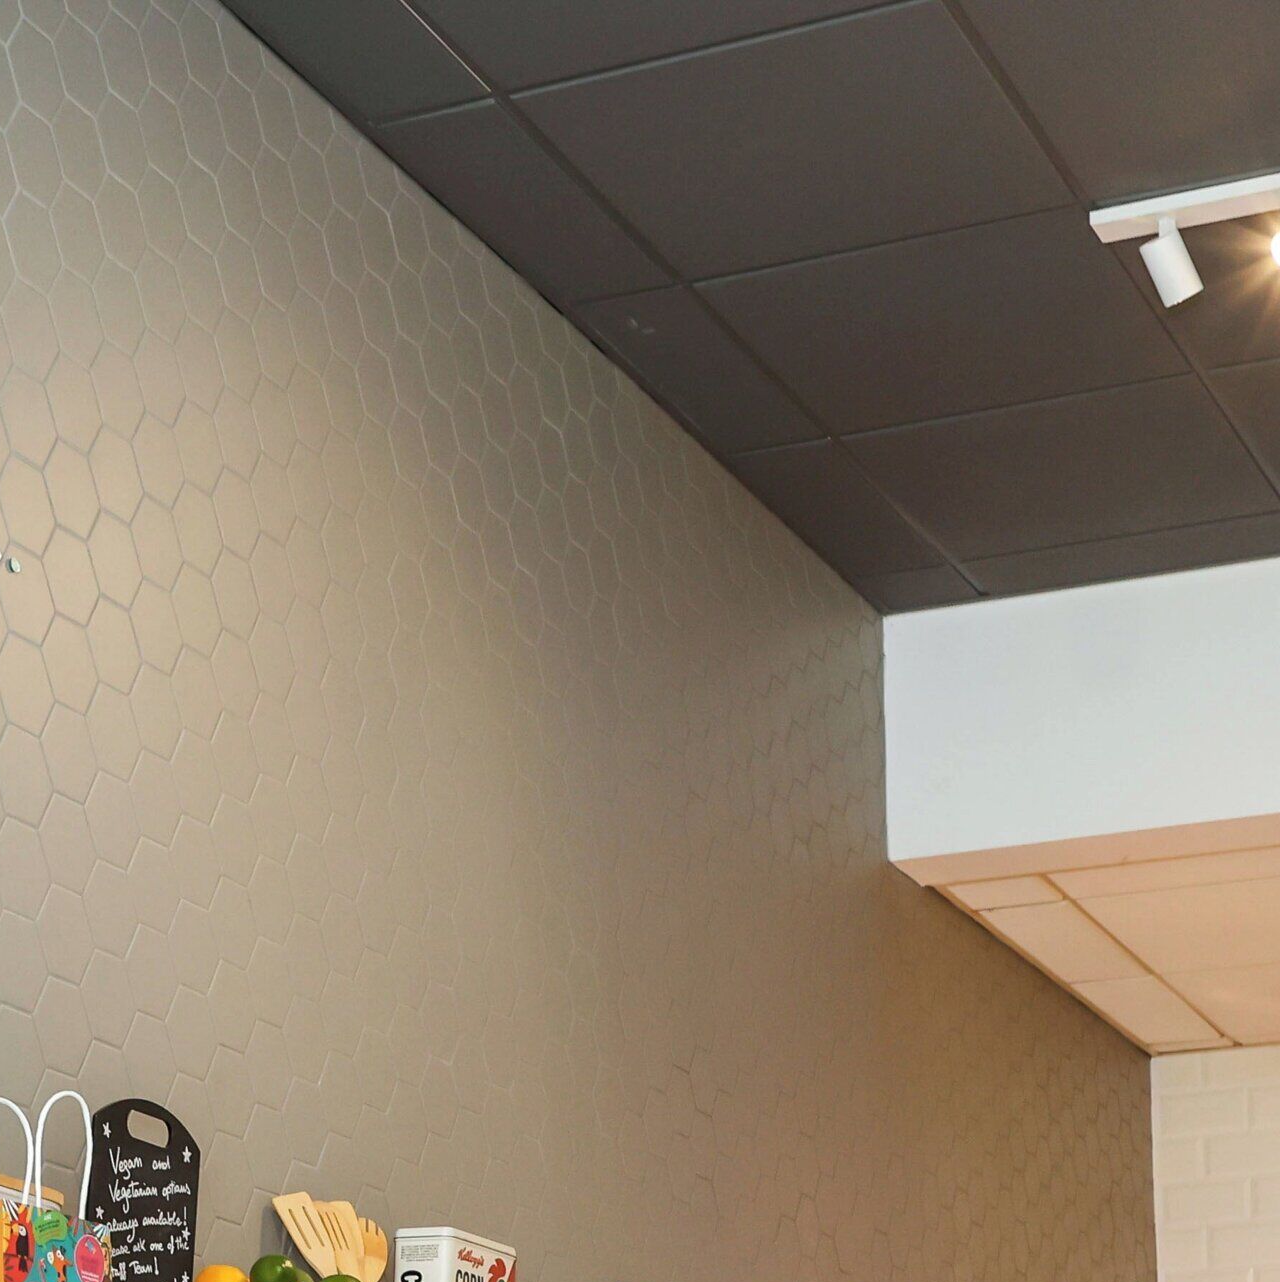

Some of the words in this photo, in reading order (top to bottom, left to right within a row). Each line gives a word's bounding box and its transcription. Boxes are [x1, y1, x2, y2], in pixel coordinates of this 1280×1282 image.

[109, 1146, 143, 1180] Vegan
[152, 1155, 171, 1171] and
[108, 1179, 158, 1214] Vegetarian
[161, 1180, 191, 1201] options
[106, 1218, 139, 1244] always
[111, 1244, 130, 1257] ease
[133, 1238, 146, 1252] ask
[149, 1242, 164, 1252] one
[167, 1234, 175, 1255] of
[175, 1236, 190, 1251] the
[458, 1247, 485, 1269] Kellogg's
[111, 1261, 127, 1281] taff
